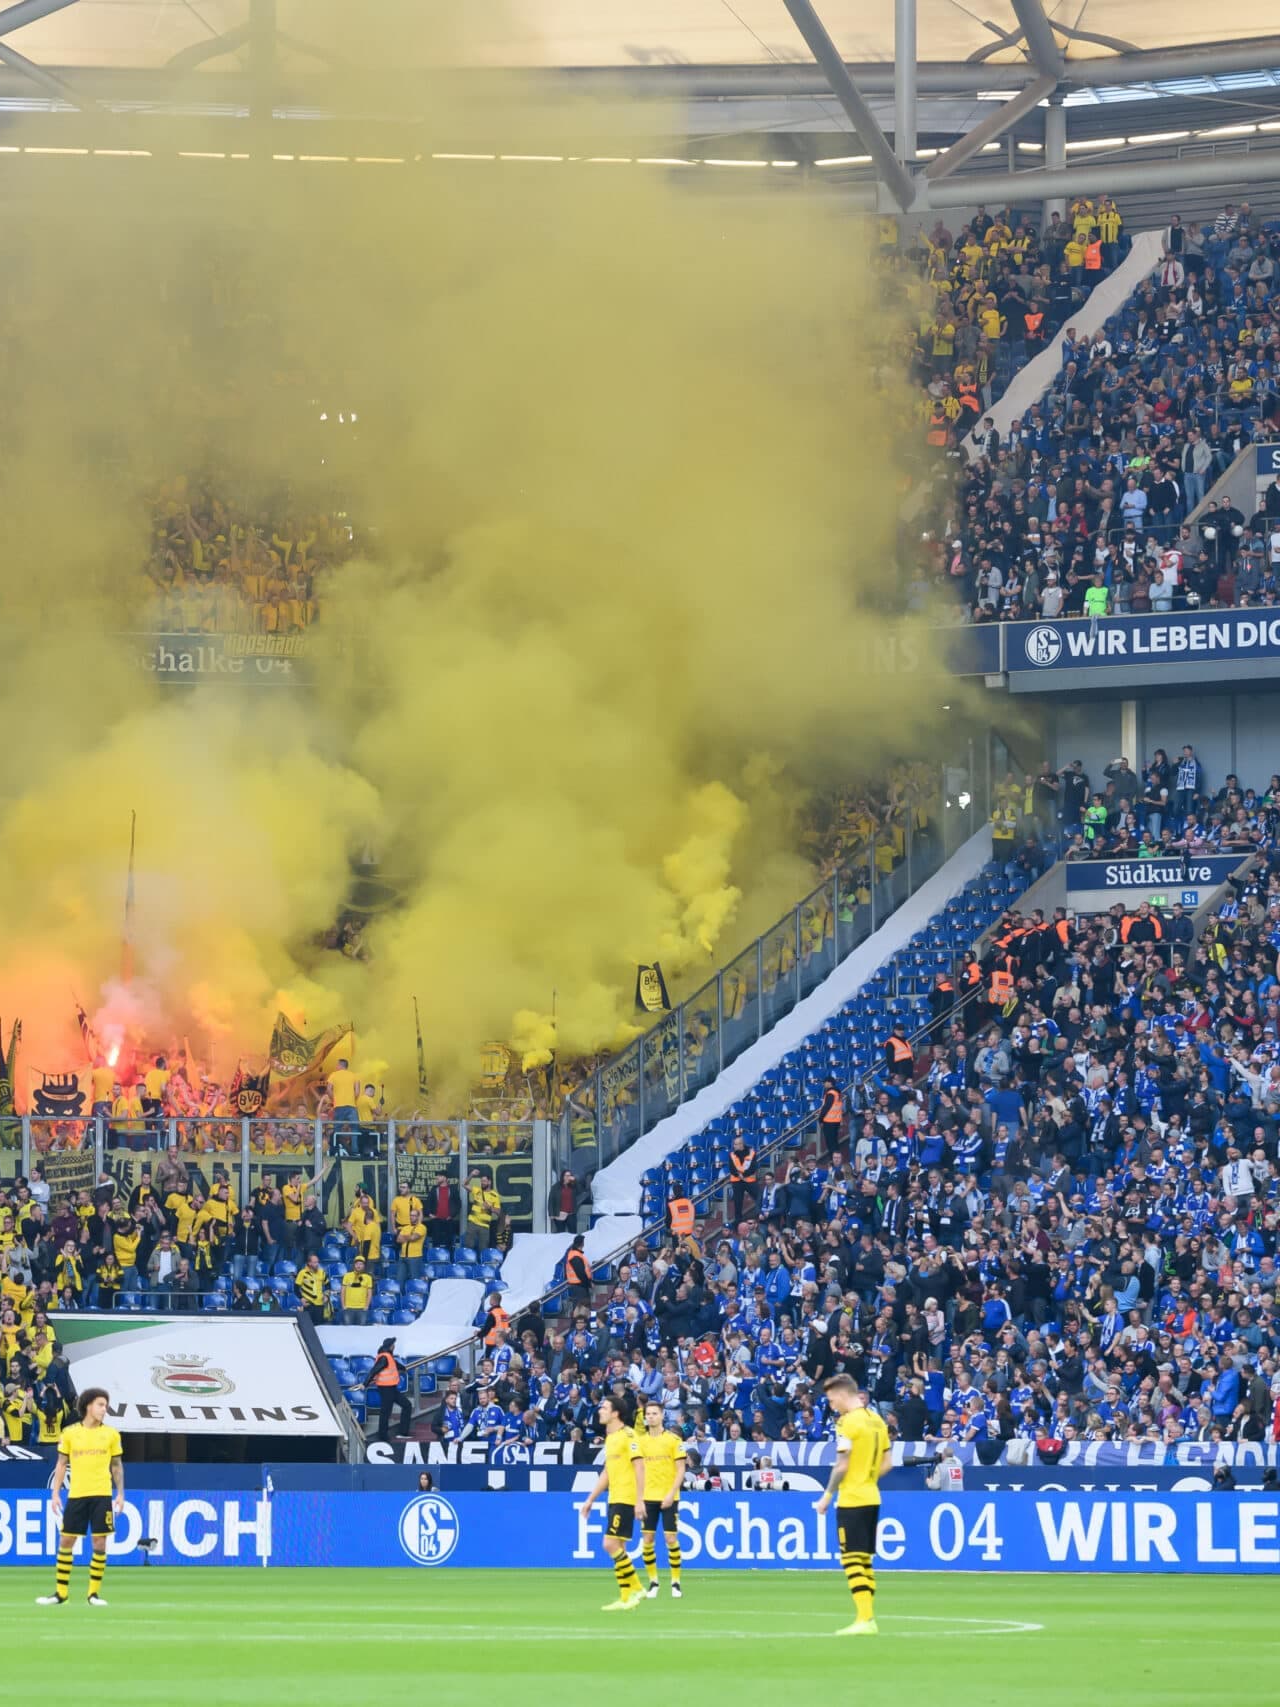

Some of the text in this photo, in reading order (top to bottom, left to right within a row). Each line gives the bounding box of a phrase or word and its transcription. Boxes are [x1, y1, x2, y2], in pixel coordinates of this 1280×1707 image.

[1067, 630, 1127, 657] WIR
[1133, 625, 1231, 653] LEBEN
[1184, 890, 1195, 904] S1
[106, 1404, 321, 1423] VELTINS
[673, 1501, 906, 1561] Schale
[929, 1502, 1004, 1561] 04
[1036, 1502, 1180, 1562] WIR
[1197, 1502, 1280, 1563] LE
